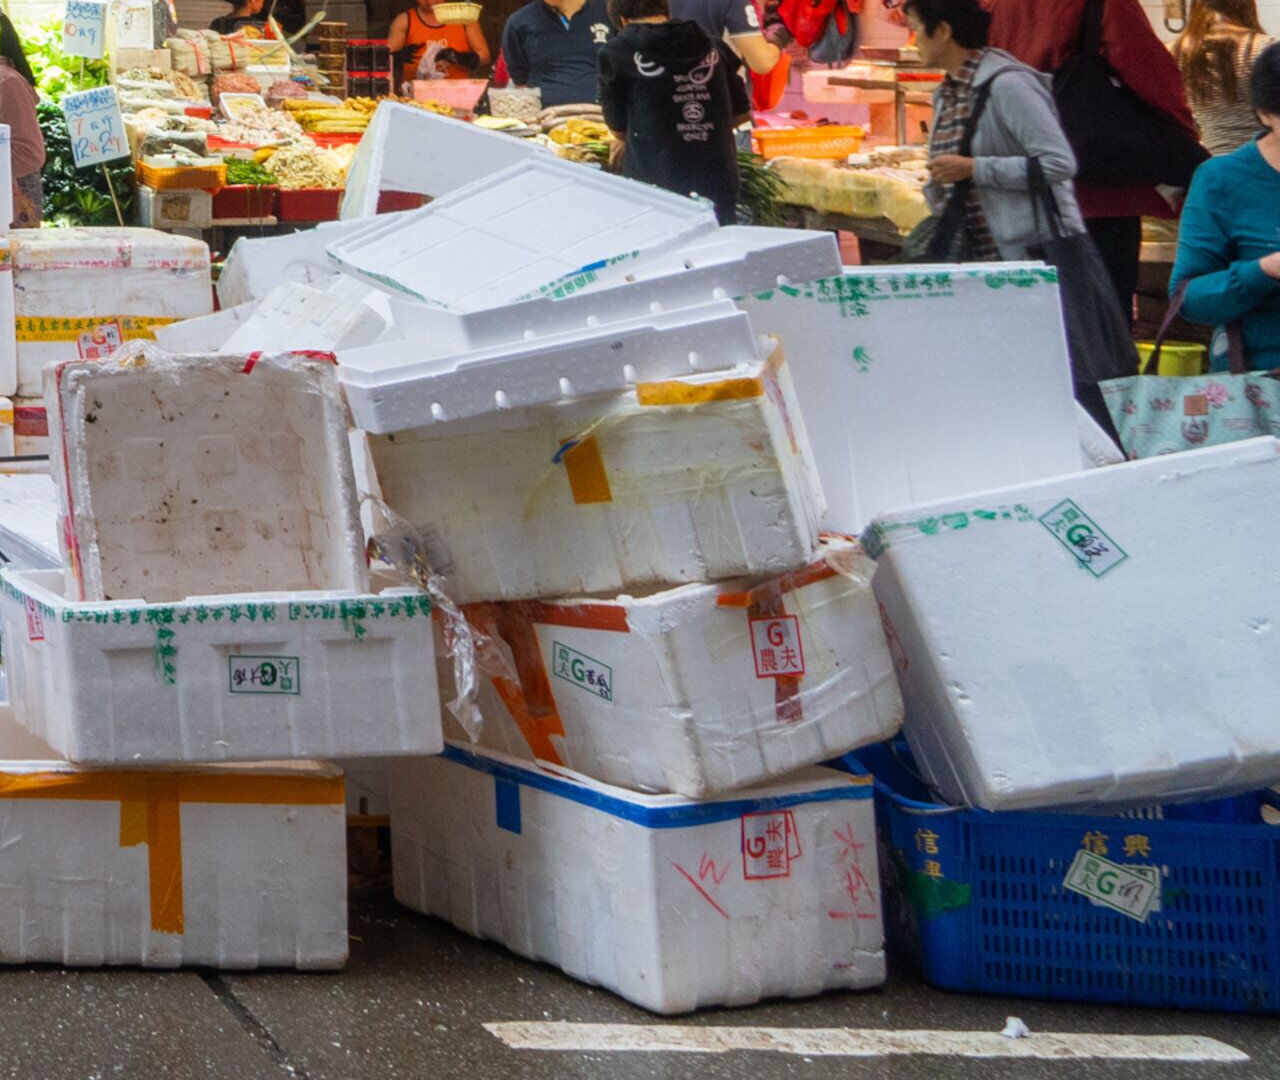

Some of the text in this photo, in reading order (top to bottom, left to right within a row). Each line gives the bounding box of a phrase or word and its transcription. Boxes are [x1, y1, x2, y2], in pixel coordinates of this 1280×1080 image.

[767, 621, 785, 647] G
[571, 660, 585, 682] G
[760, 646, 800, 671] 農夫
[746, 836, 767, 860] G
[1096, 871, 1121, 896] G
